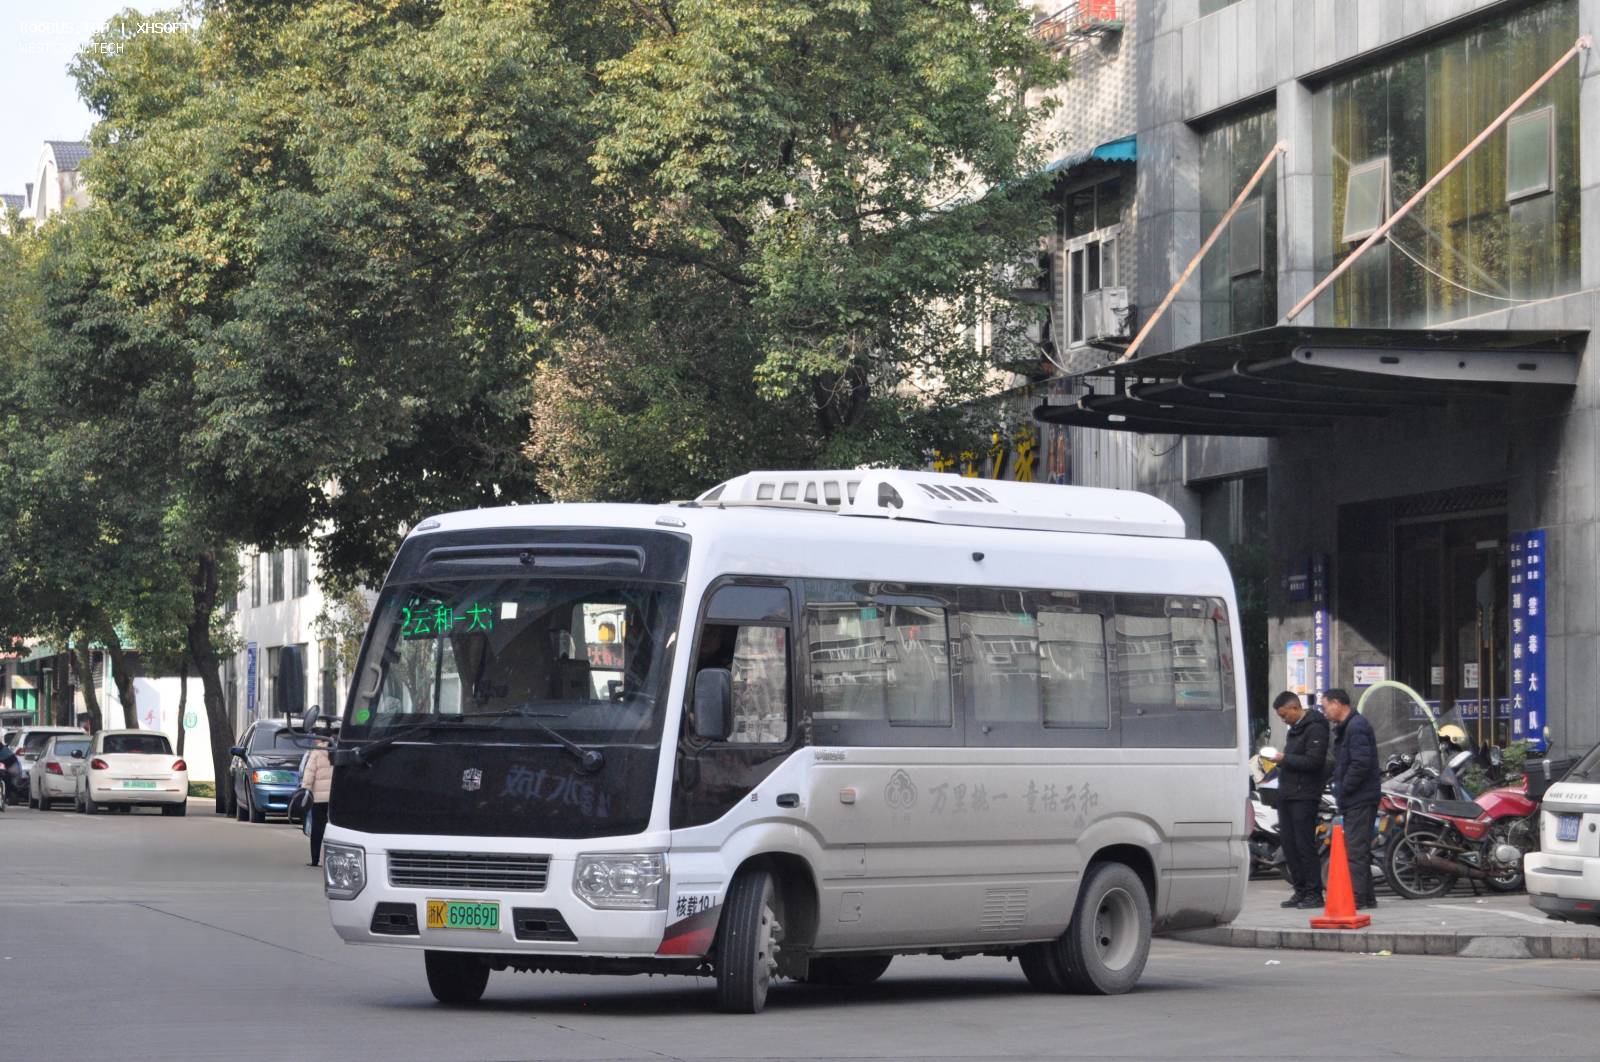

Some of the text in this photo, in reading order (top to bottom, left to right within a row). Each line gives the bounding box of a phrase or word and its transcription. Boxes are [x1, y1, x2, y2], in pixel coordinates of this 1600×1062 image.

[1528, 597, 1538, 730] 禁毒大队
[1021, 779, 1099, 814] 童话云和
